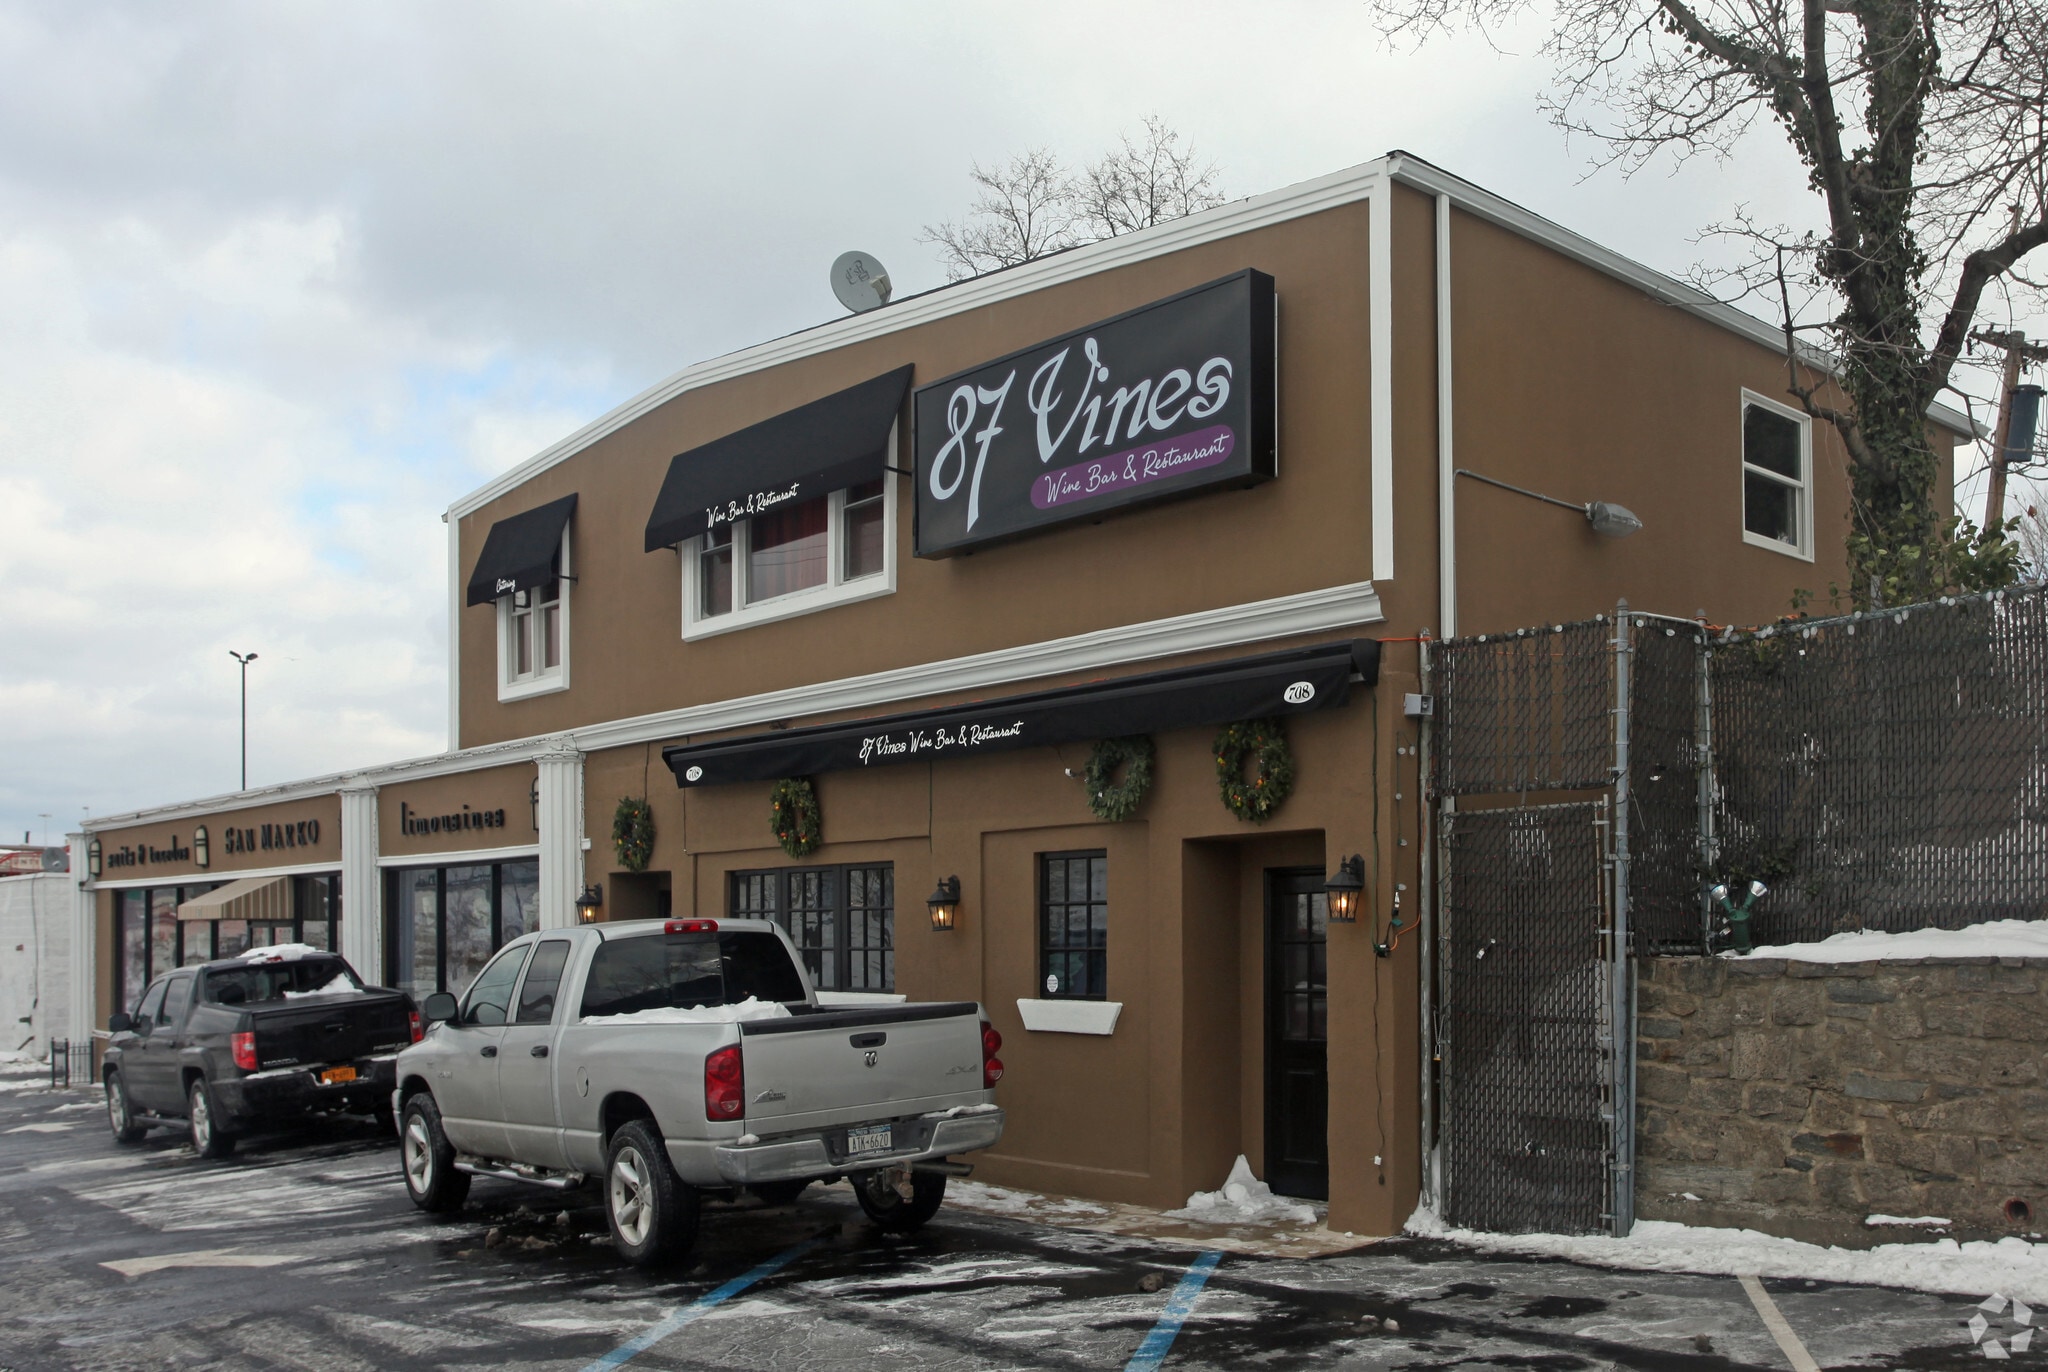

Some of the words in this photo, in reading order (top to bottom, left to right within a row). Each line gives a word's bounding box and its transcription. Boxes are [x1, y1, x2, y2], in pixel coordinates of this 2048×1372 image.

[930, 369, 1017, 533] 87
[1028, 338, 1233, 463] Vines
[1044, 472, 1081, 503] Wine
[1085, 464, 1117, 493] Bar
[1123, 454, 1137, 482] &
[1142, 433, 1230, 478] Restaurant
[706, 505, 726, 528] Wine
[728, 500, 745, 521] Bar
[746, 494, 754, 514] &
[756, 482, 800, 512] Restaurant
[1289, 684, 1310, 700] 708
[859, 737, 875, 765] 87
[876, 735, 907, 756] Vines
[909, 730, 932, 753] Wine
[935, 728, 955, 750] Bar
[958, 725, 967, 746] &
[970, 720, 1024, 745] Restaurant
[225, 826, 256, 854] SAN
[261, 818, 320, 850] MARKO
[401, 801, 505, 836] limousines
